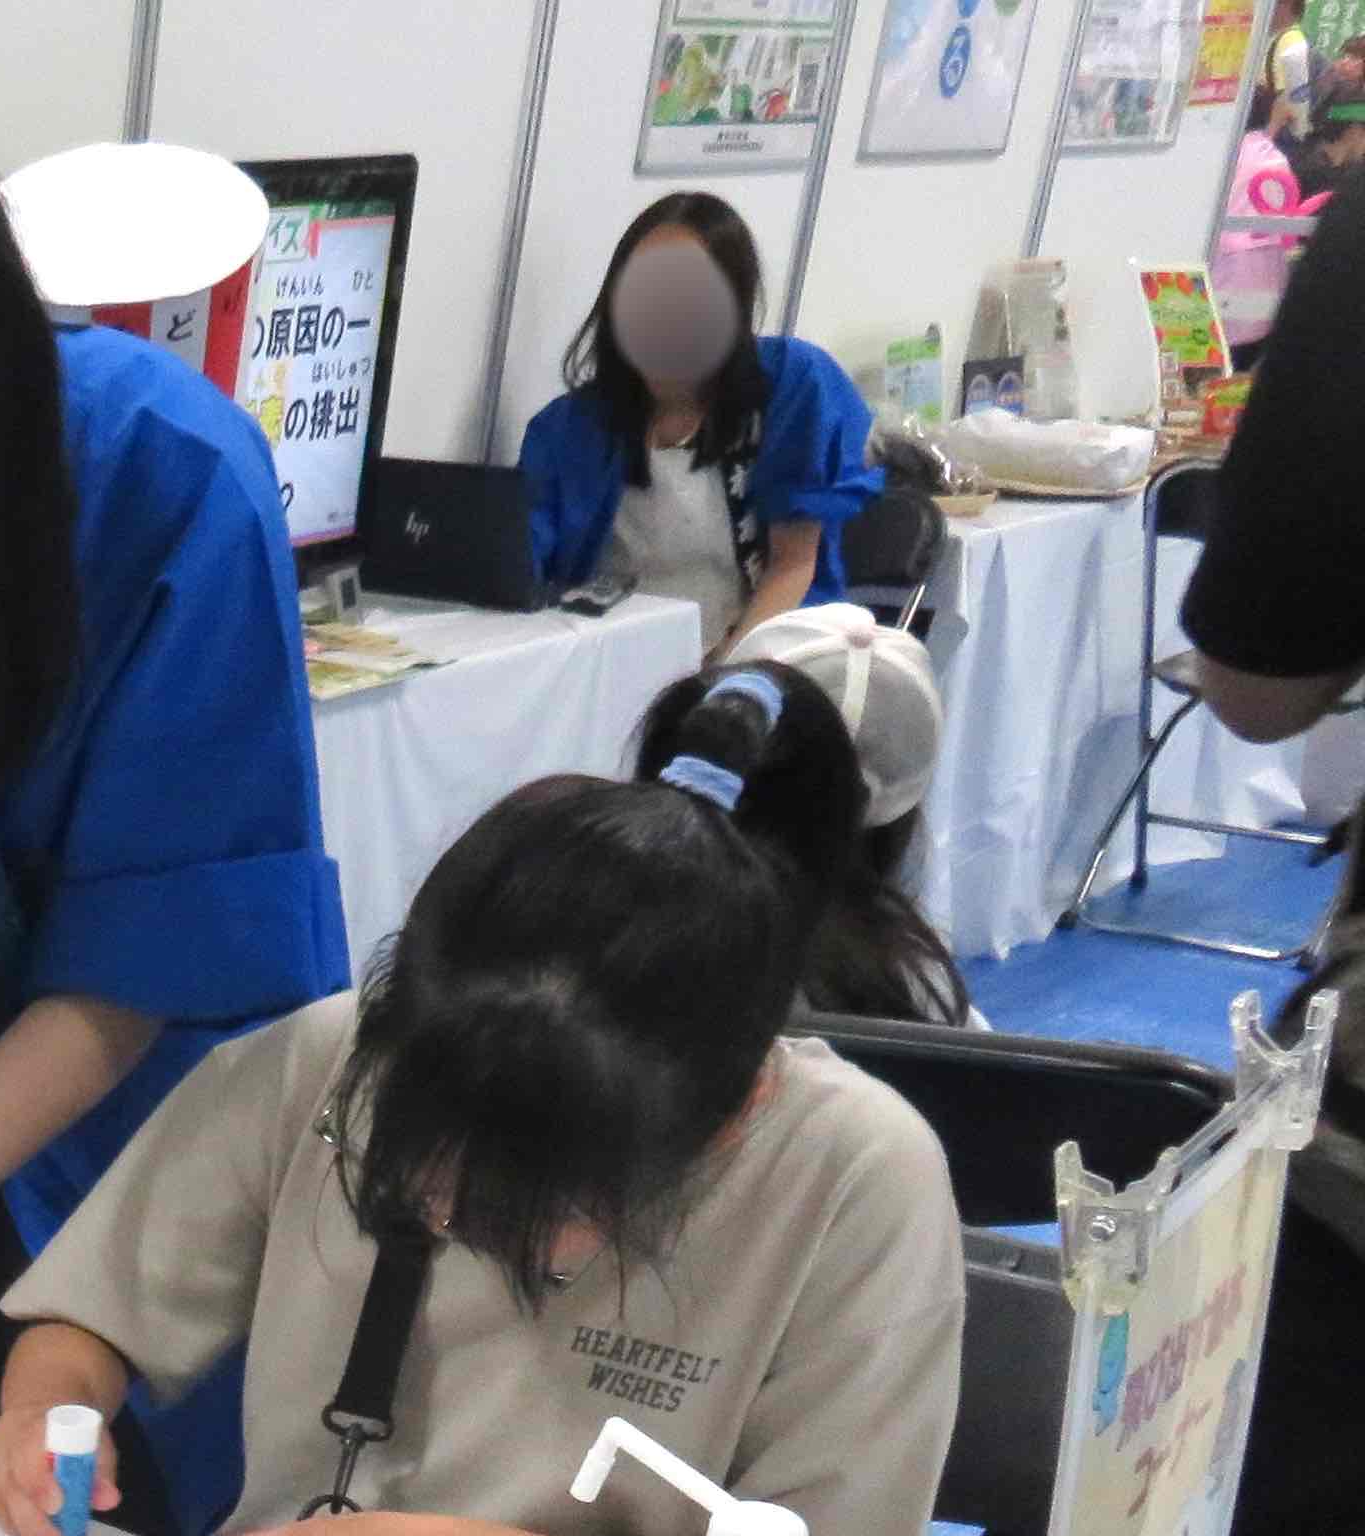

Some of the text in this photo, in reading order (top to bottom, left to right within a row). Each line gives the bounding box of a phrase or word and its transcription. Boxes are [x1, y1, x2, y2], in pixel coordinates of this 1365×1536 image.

[405, 511, 430, 542] hp
[570, 1325, 721, 1384] HEARTFELT
[587, 1361, 686, 1413] WISHES
